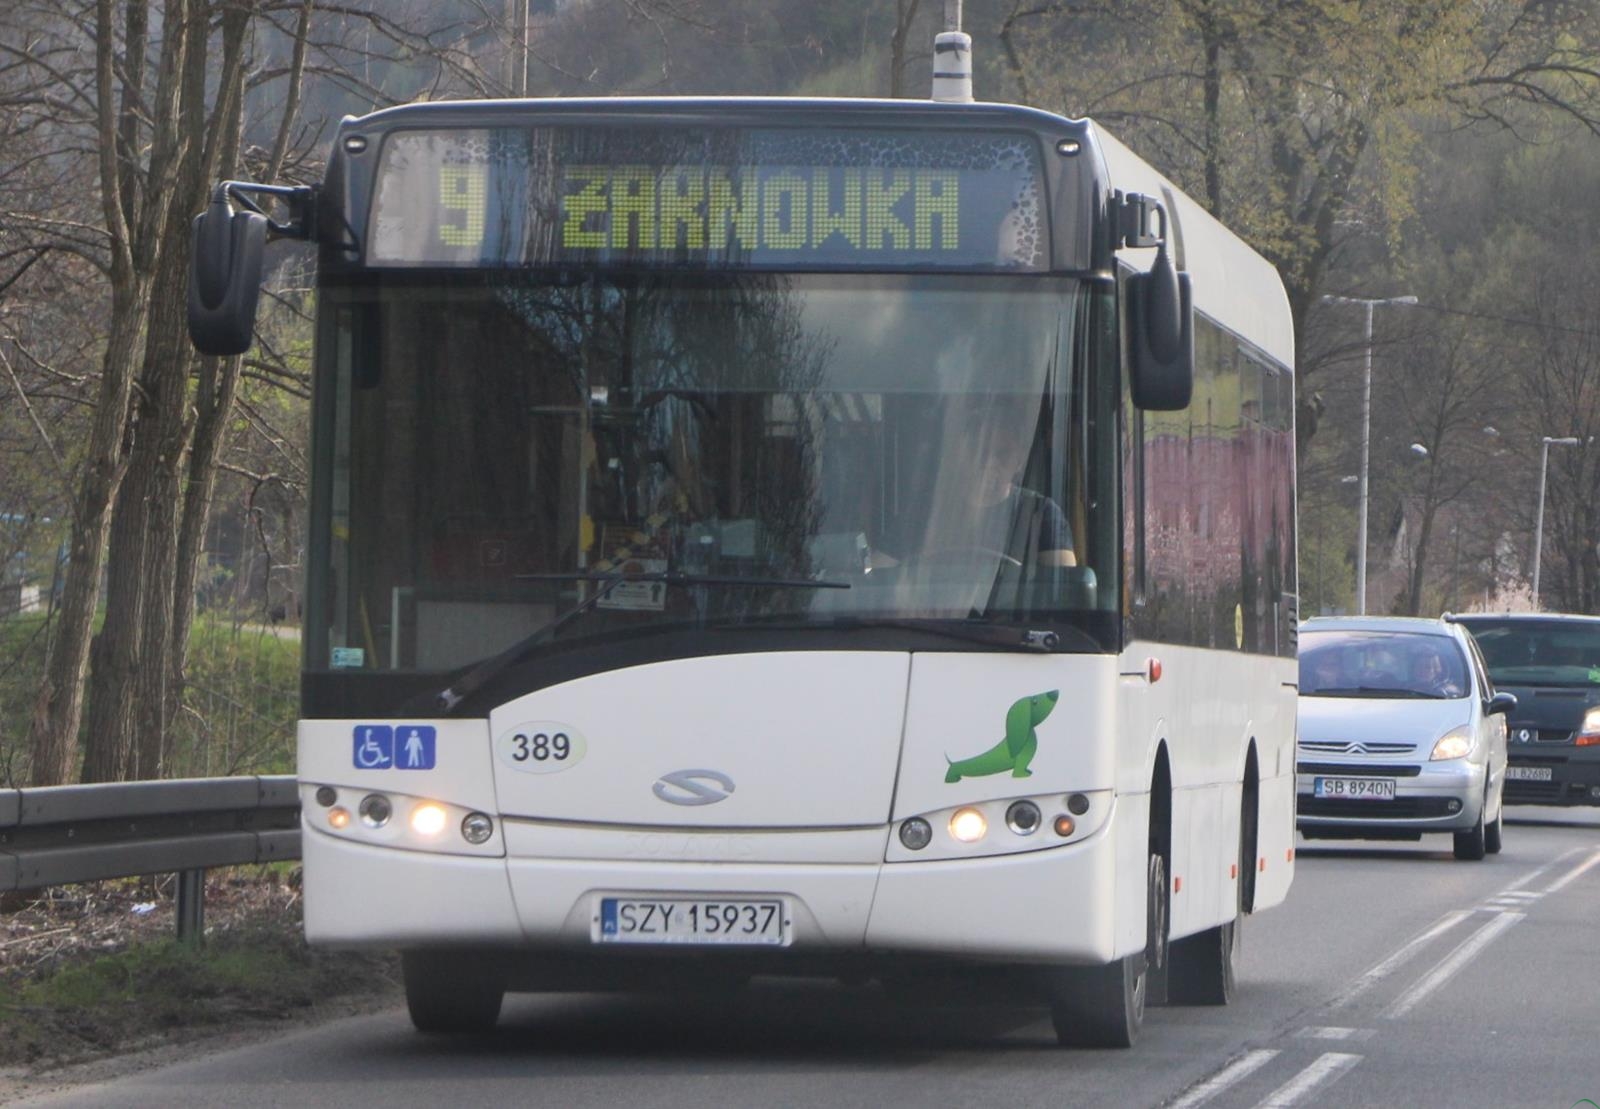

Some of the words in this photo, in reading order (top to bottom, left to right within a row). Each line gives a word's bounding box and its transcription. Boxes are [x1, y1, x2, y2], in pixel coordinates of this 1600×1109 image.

[440, 166, 484, 247] 9
[511, 732, 571, 762] 389
[1324, 780, 1344, 794] SB
[1349, 781, 1393, 796] 8940N
[620, 903, 675, 933] SZY
[688, 904, 777, 934] 15937
